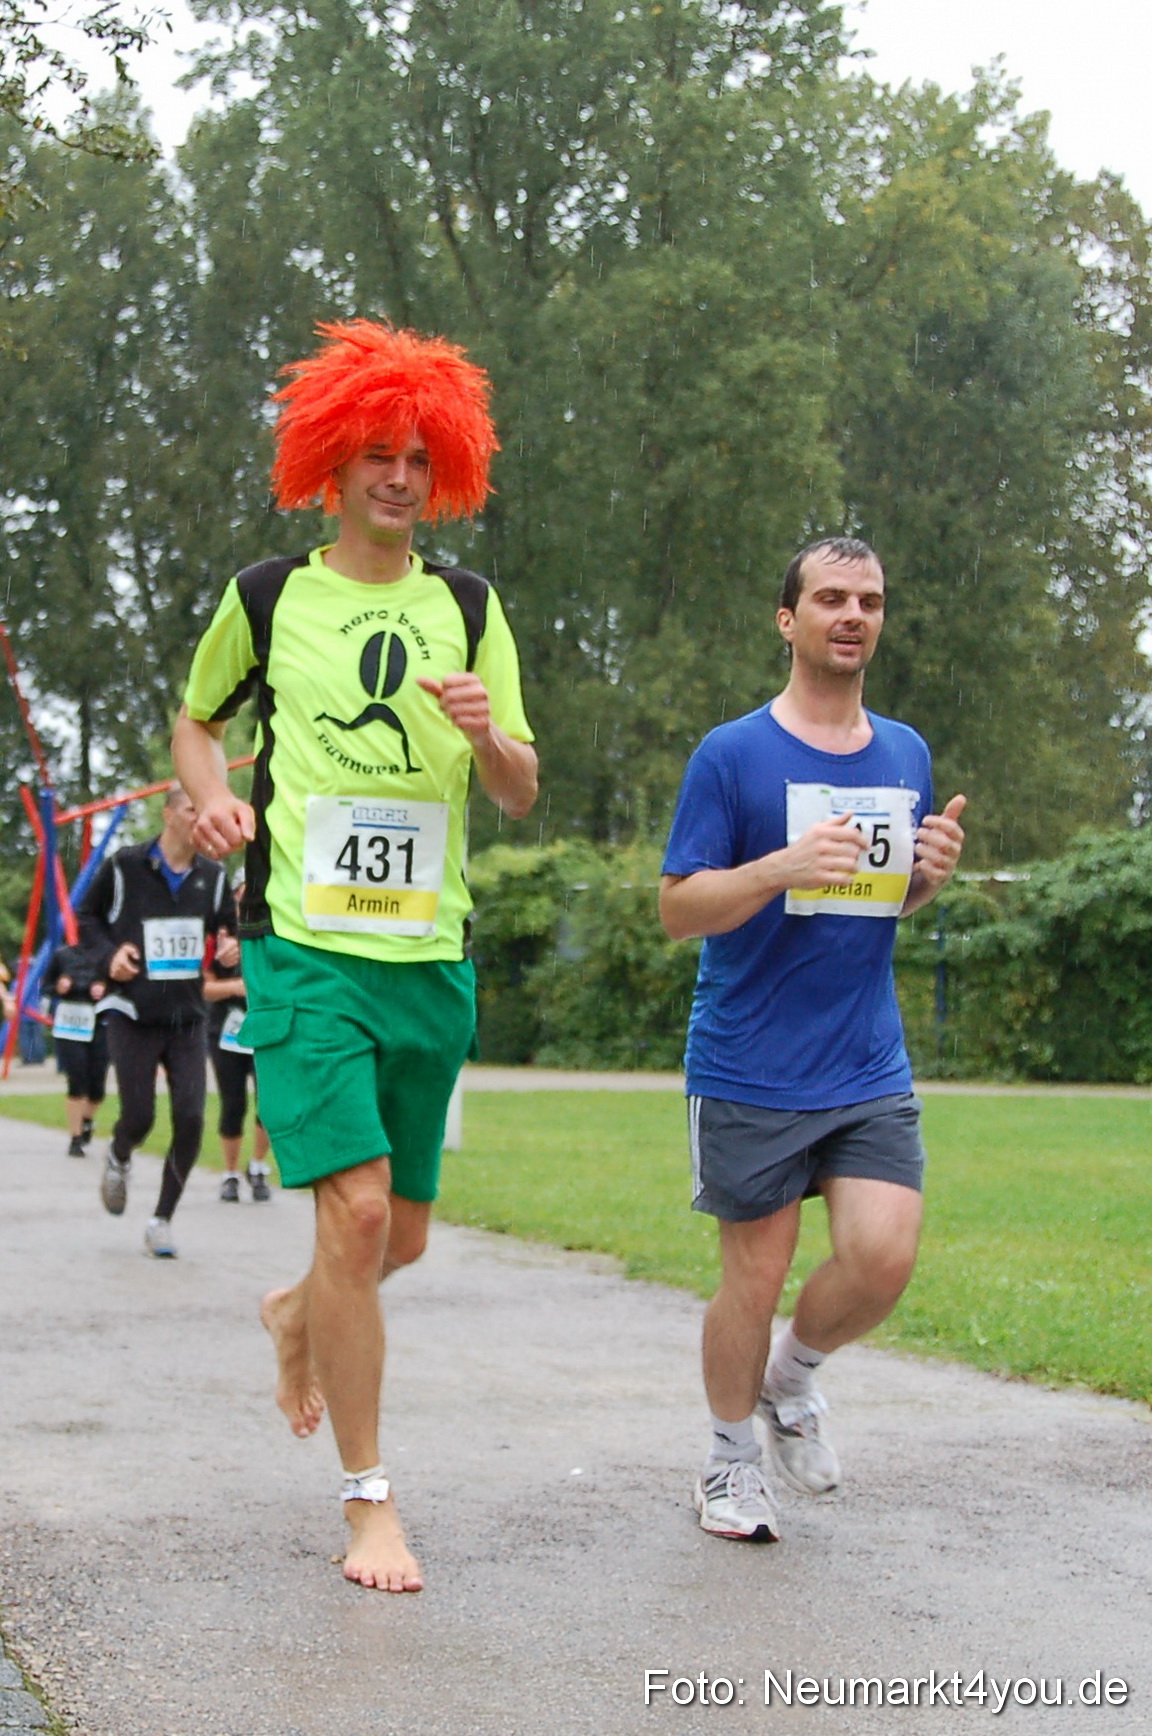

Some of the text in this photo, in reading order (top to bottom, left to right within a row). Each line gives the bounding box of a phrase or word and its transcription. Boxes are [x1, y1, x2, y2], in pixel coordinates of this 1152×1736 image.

[339, 610, 431, 661] nero bean
[317, 733, 401, 775] runners
[334, 835, 414, 884] 431
[346, 893, 401, 915] Armin
[153, 936, 198, 958] 3197
